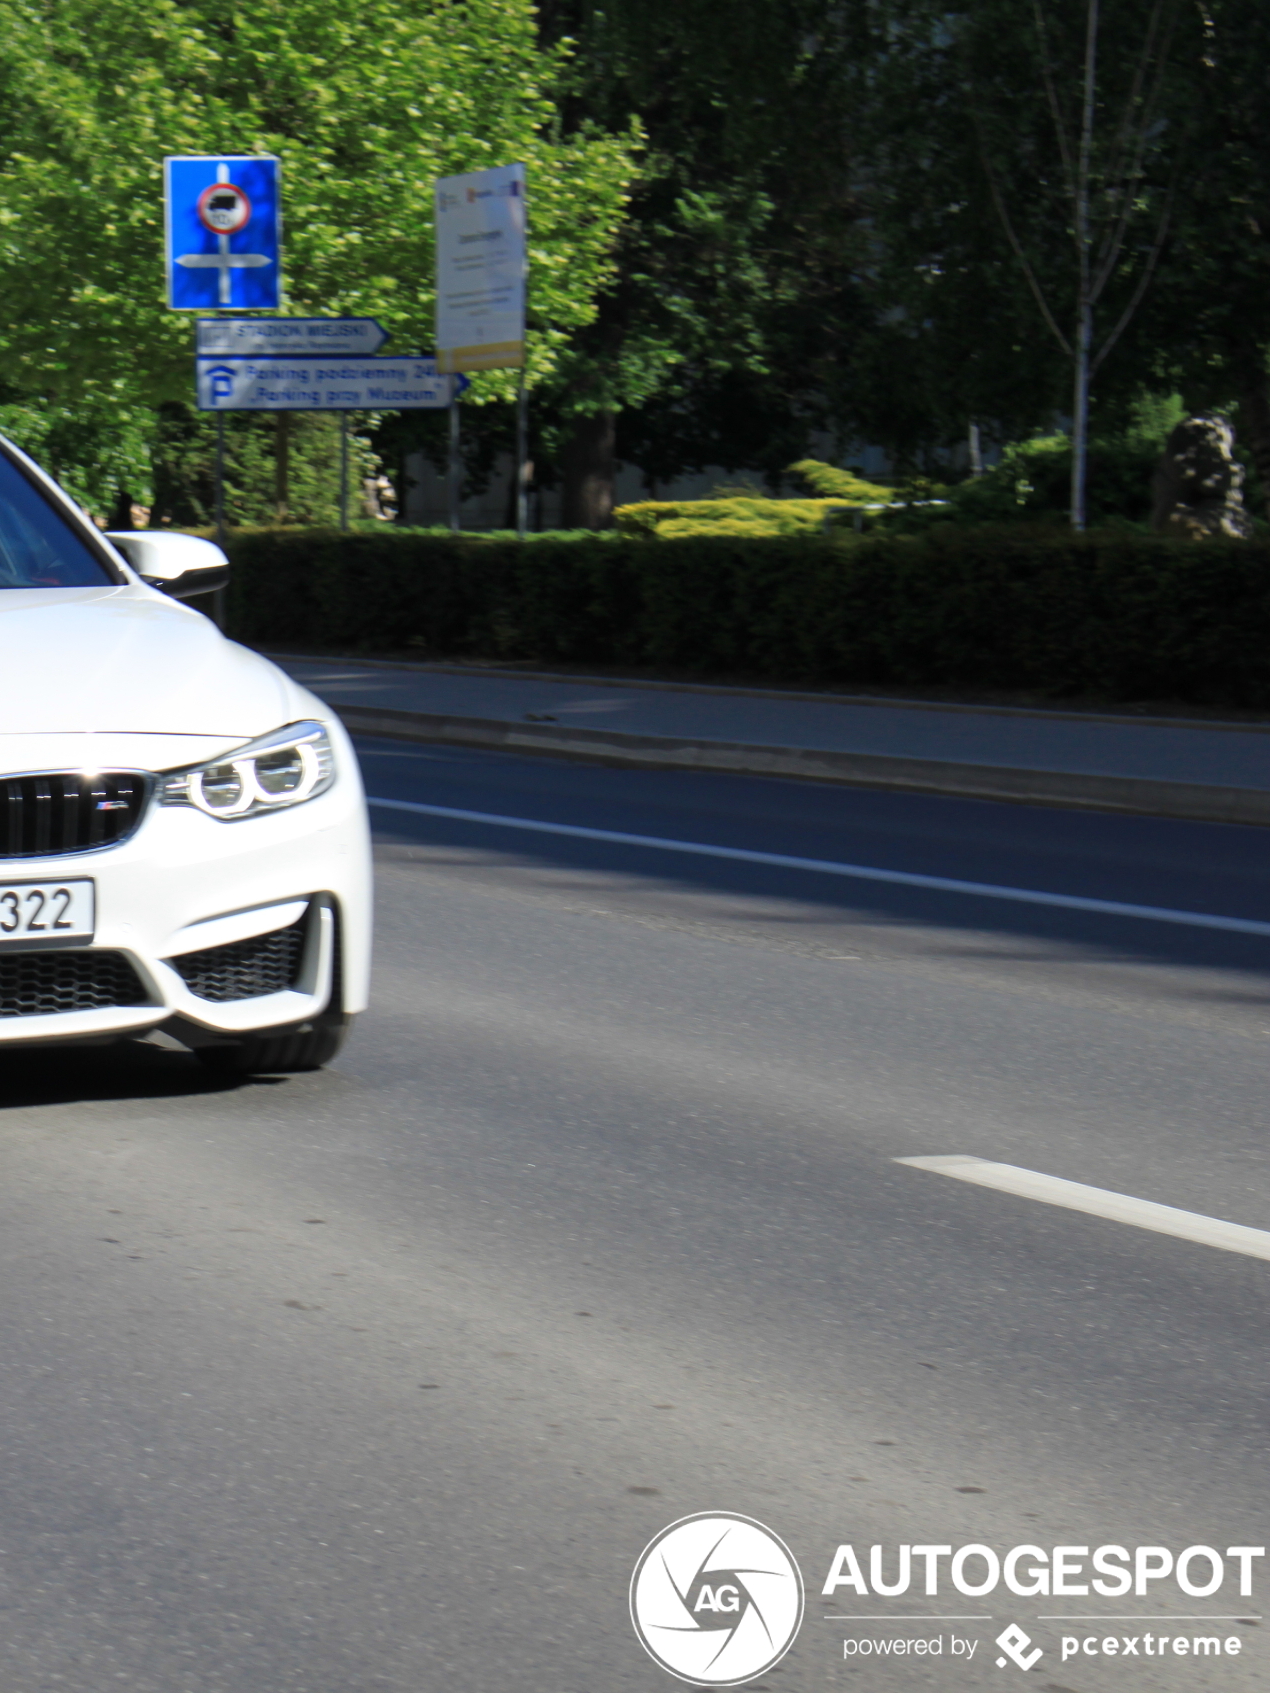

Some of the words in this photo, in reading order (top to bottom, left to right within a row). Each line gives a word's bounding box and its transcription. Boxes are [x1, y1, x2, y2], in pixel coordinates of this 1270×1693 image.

[237, 324, 301, 337] STADION
[307, 324, 368, 336] MIEJSKI
[245, 366, 310, 383] Parking
[315, 365, 407, 382] podziemny
[326, 389, 362, 404] przy
